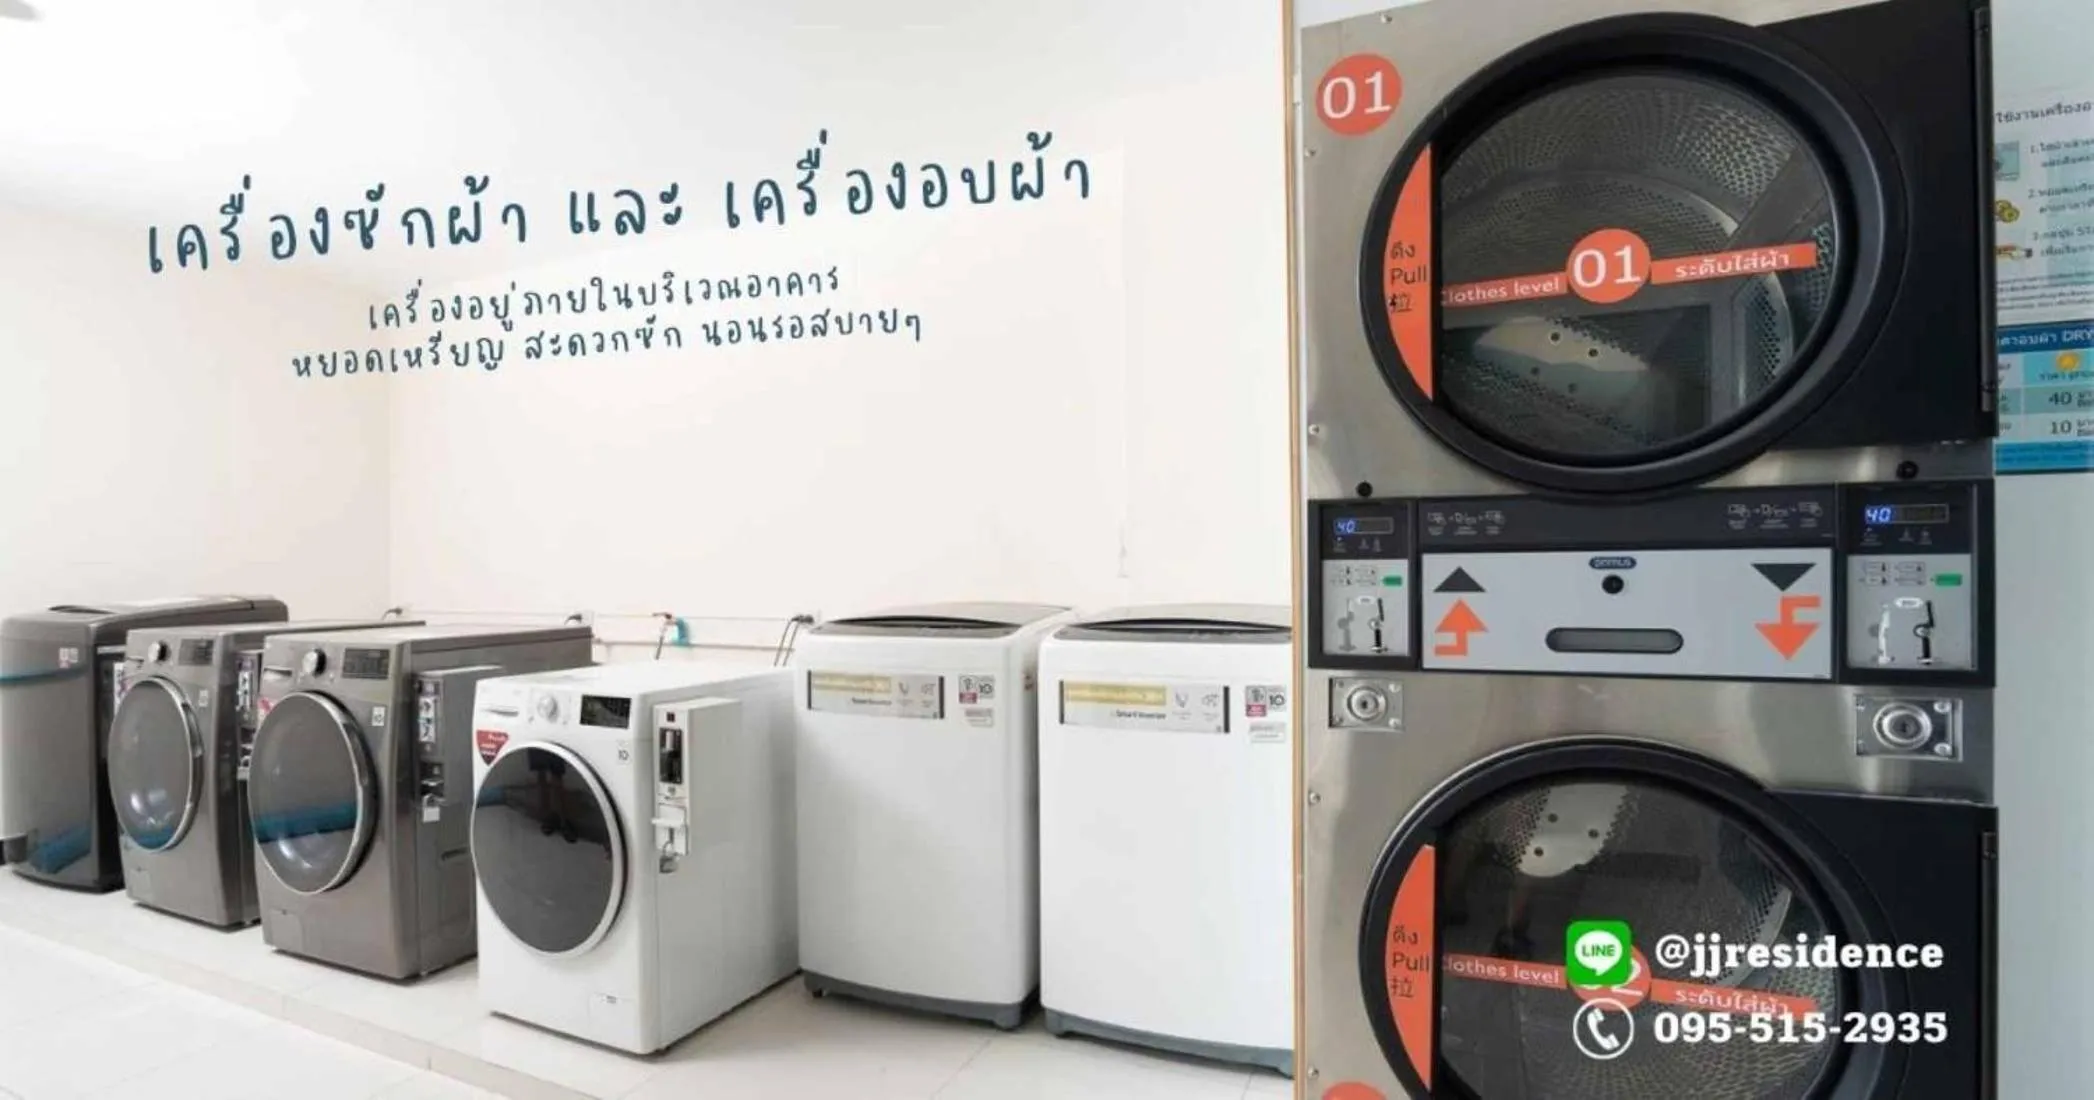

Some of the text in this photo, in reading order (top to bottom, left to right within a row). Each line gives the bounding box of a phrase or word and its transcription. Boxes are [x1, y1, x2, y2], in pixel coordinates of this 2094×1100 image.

[1322, 70, 1391, 118] 01
[1391, 265, 1427, 285] Pull
[1574, 245, 1642, 288] 01
[1514, 277, 1560, 296] level
[2048, 391, 2072, 405] 40
[2052, 420, 2072, 435] 10
[1866, 507, 1891, 523] 40
[1337, 520, 1355, 533] 40
[1392, 953, 1430, 972] Pull
[1514, 963, 1560, 984] level
